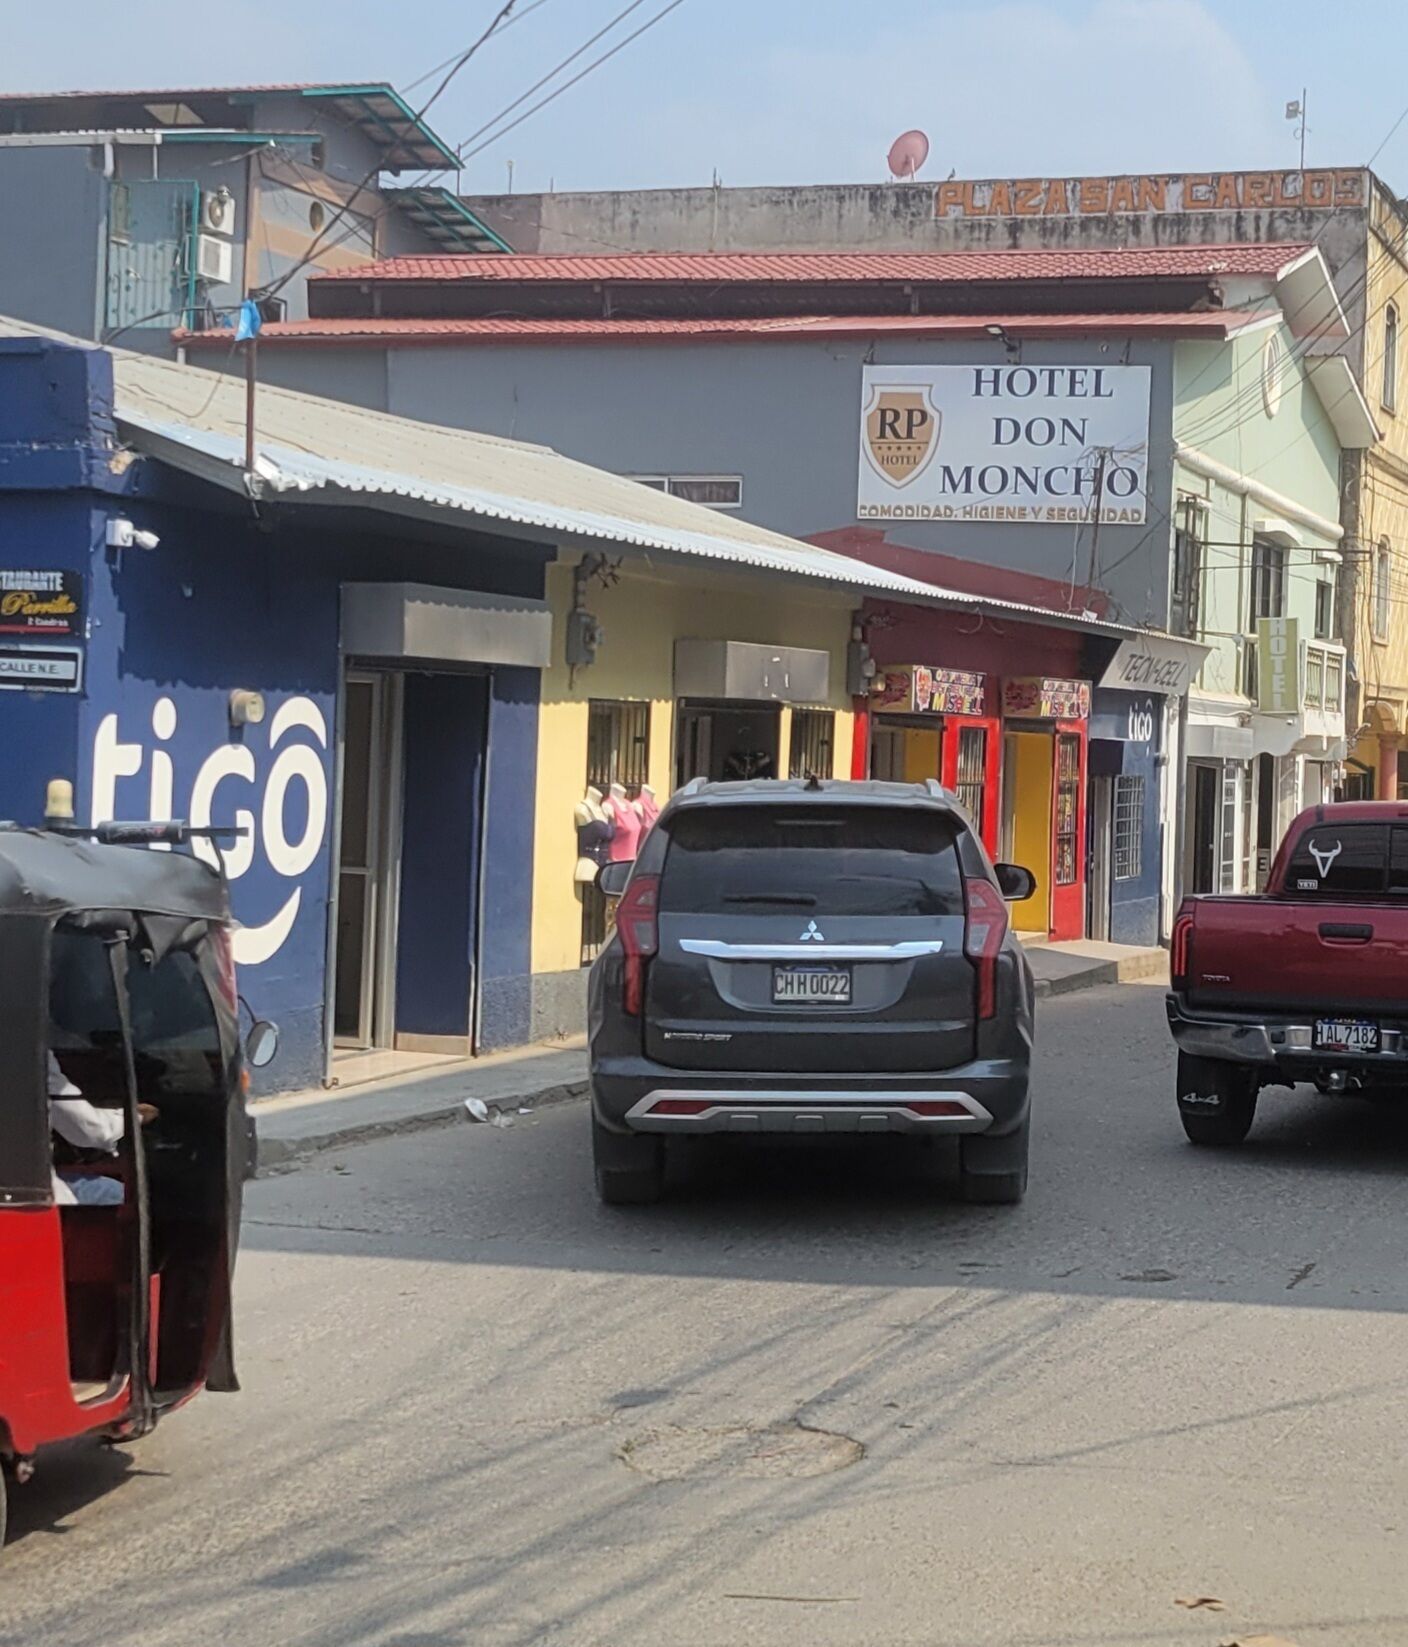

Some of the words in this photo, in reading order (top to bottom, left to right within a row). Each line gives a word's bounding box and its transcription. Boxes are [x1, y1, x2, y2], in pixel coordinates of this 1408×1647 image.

[938, 178, 1069, 217] PLAZA
[1077, 176, 1170, 214] SAN
[1183, 170, 1363, 209] CARLOS
[971, 367, 1113, 398] HOTEL
[876, 408, 928, 440] RP
[992, 417, 1089, 446] DON
[881, 455, 918, 466] HOTEL
[939, 465, 1139, 497] MONCHO
[962, 506, 1027, 520] HIGIENE
[1032, 507, 1042, 520] Y
[0, 662, 36, 673] CALLE
[1269, 619, 1288, 711] HOTEL
